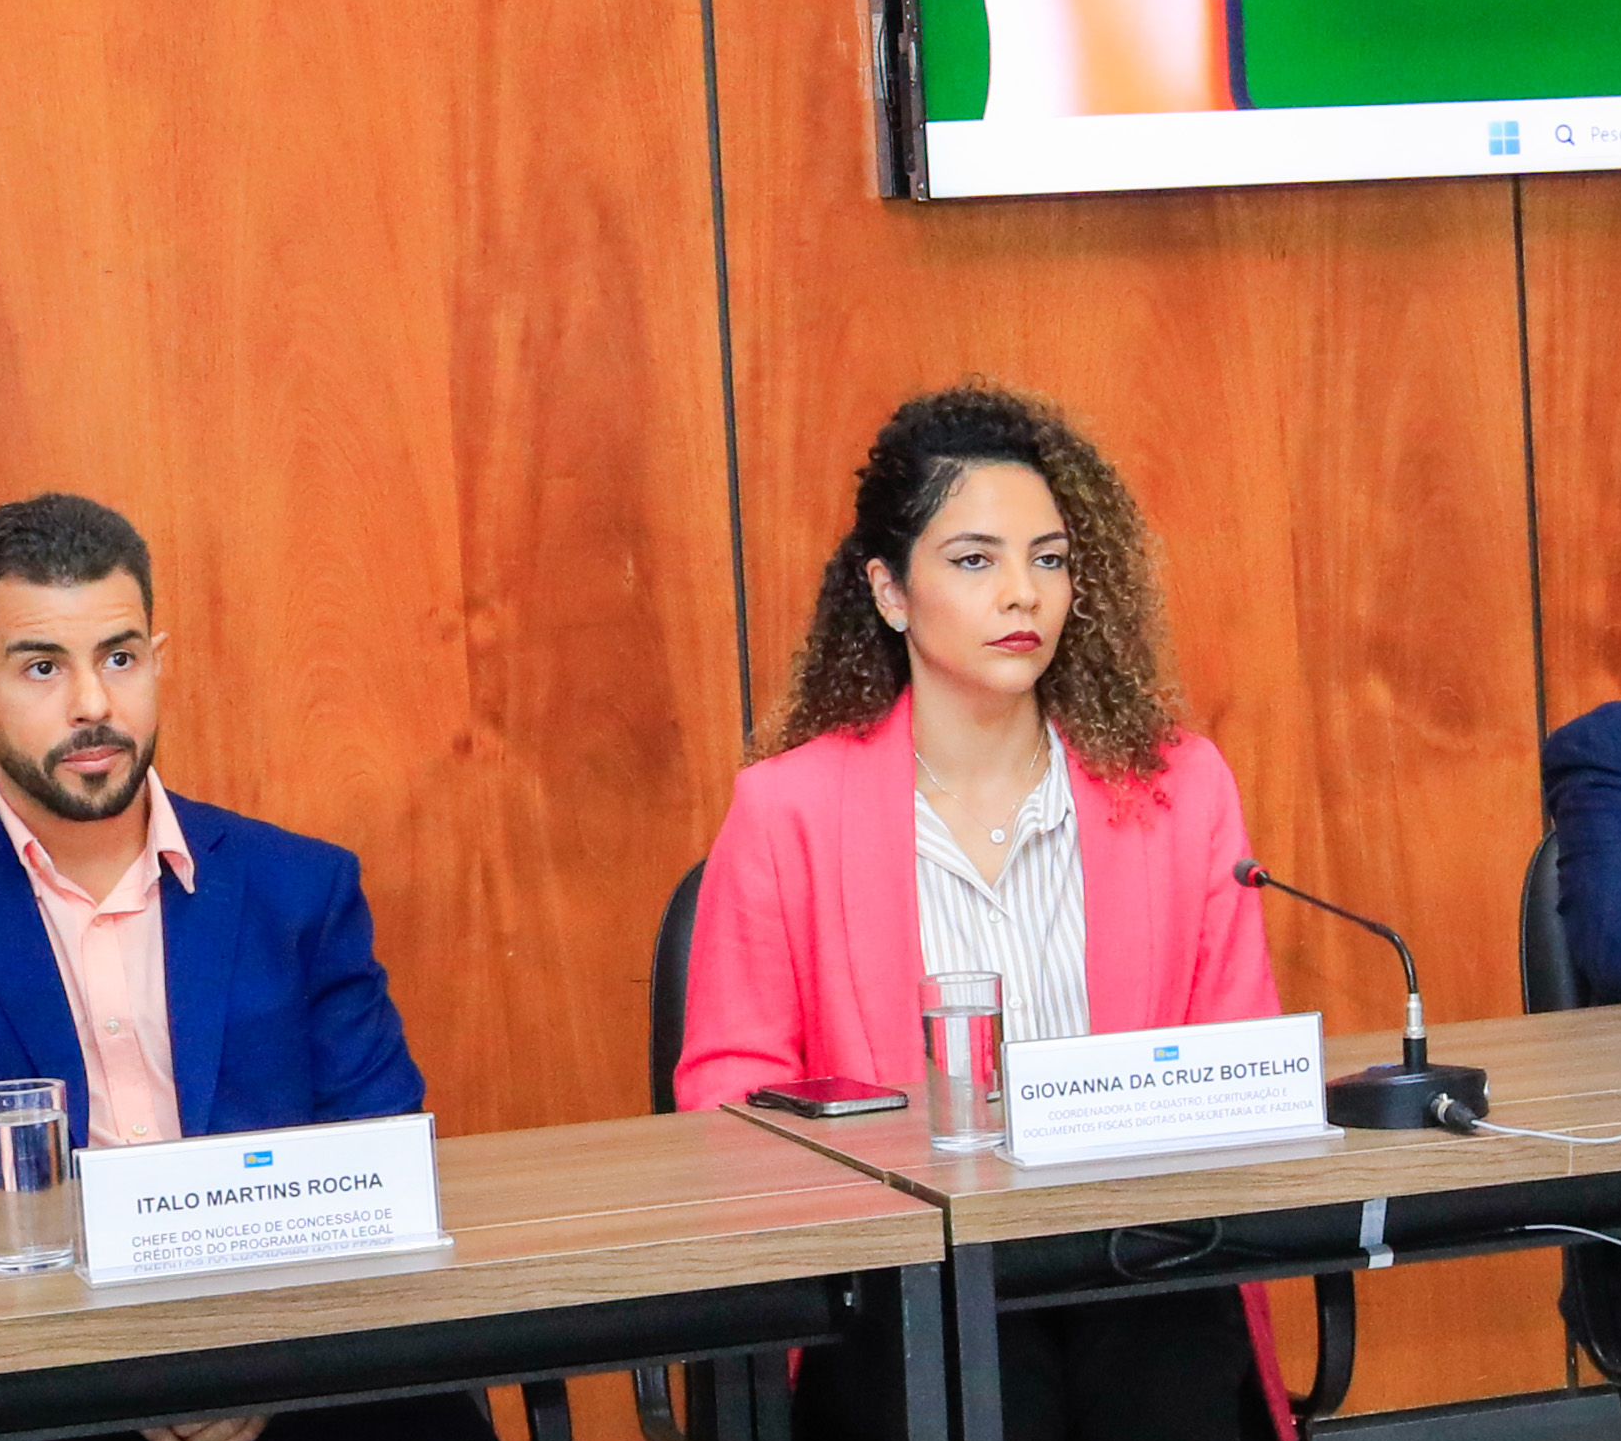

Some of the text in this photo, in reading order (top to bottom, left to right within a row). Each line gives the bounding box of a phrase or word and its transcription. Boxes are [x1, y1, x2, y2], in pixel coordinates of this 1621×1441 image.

[1020, 1056, 1310, 1100] GIOVANNA DA CRUZ BOTELHO
[1023, 1099, 1314, 1138] DOCUMENTOS FISCAIS DIGITAIS DA SECRETARIA DE FAZENDA
[1048, 1102, 1132, 1121] COORDENADORA
[1135, 1100, 1148, 1113] DE
[1207, 1086, 1276, 1106] ESCRITURAÇÃO
[1278, 1087, 1287, 1097] E
[137, 1172, 384, 1215] ITALO MARTINS ROCHA
[132, 1208, 393, 1247] CHEFE DO NÚCLEO DE CONCESSÃO DE
[133, 1223, 394, 1263] CRÉDITOS DO PROGRAMA NOTA LEGAL
